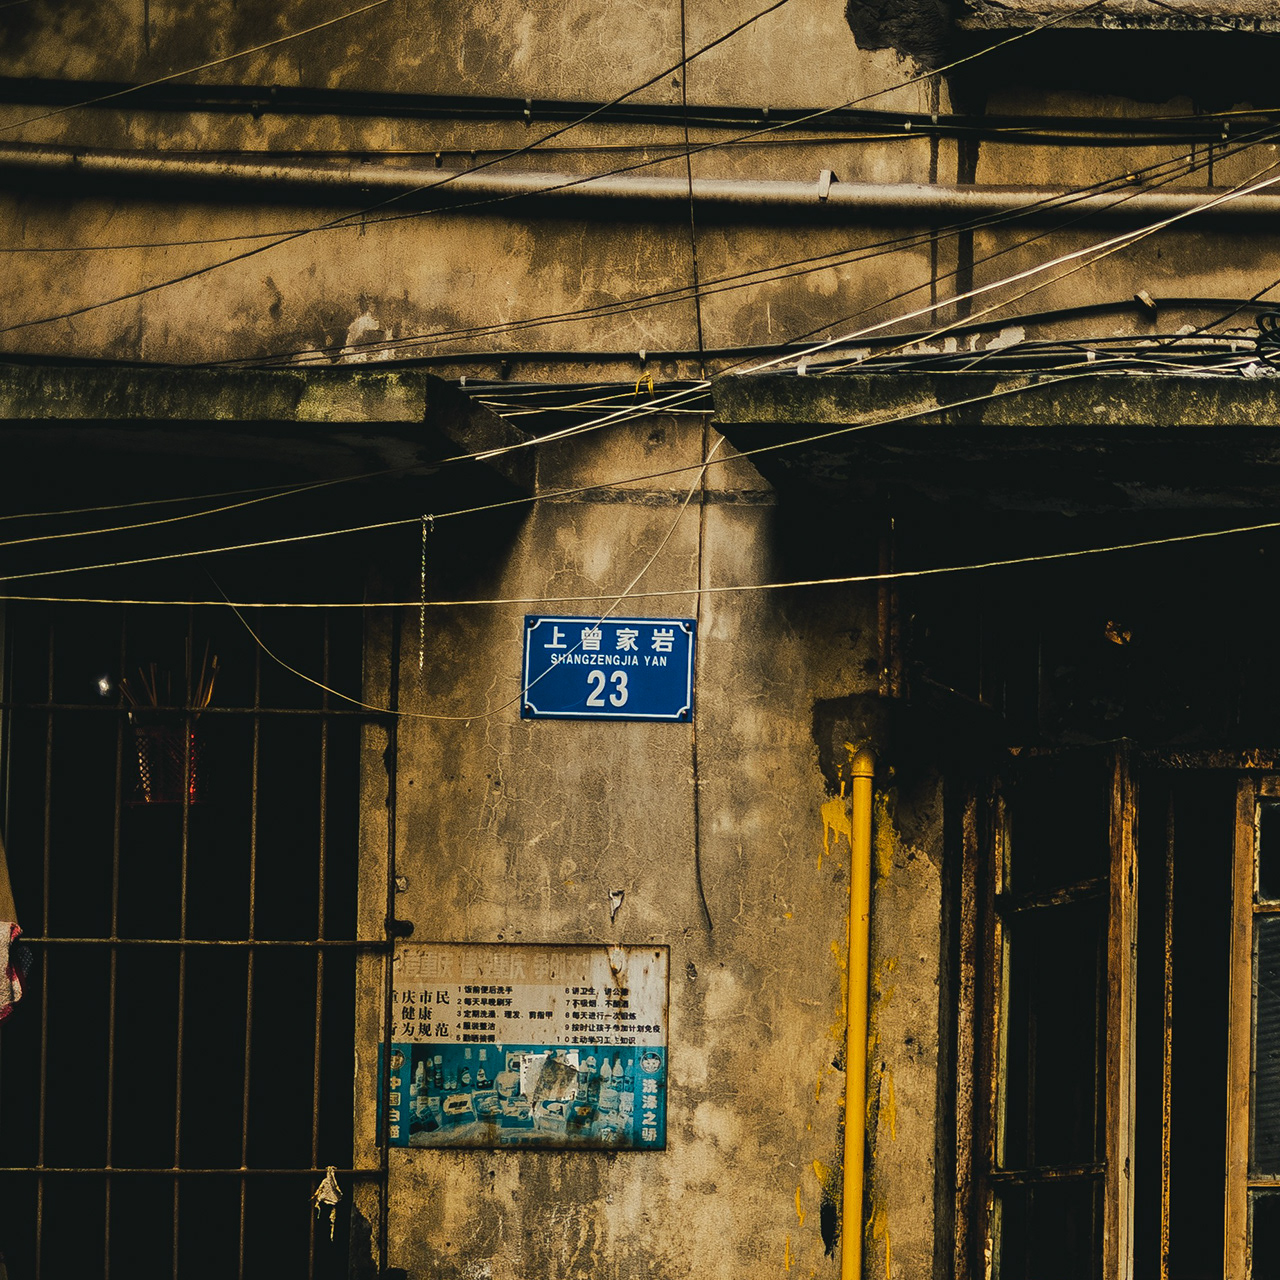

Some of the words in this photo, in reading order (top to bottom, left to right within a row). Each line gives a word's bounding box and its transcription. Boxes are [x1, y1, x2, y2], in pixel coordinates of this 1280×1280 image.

[543, 626, 676, 652] 上曾家岩
[550, 653, 639, 667] SHANGZENGJIA
[644, 655, 667, 667] YAN
[586, 669, 629, 708] 23
[401, 1005, 433, 1021] 健康
[456, 1022, 462, 1030] 4
